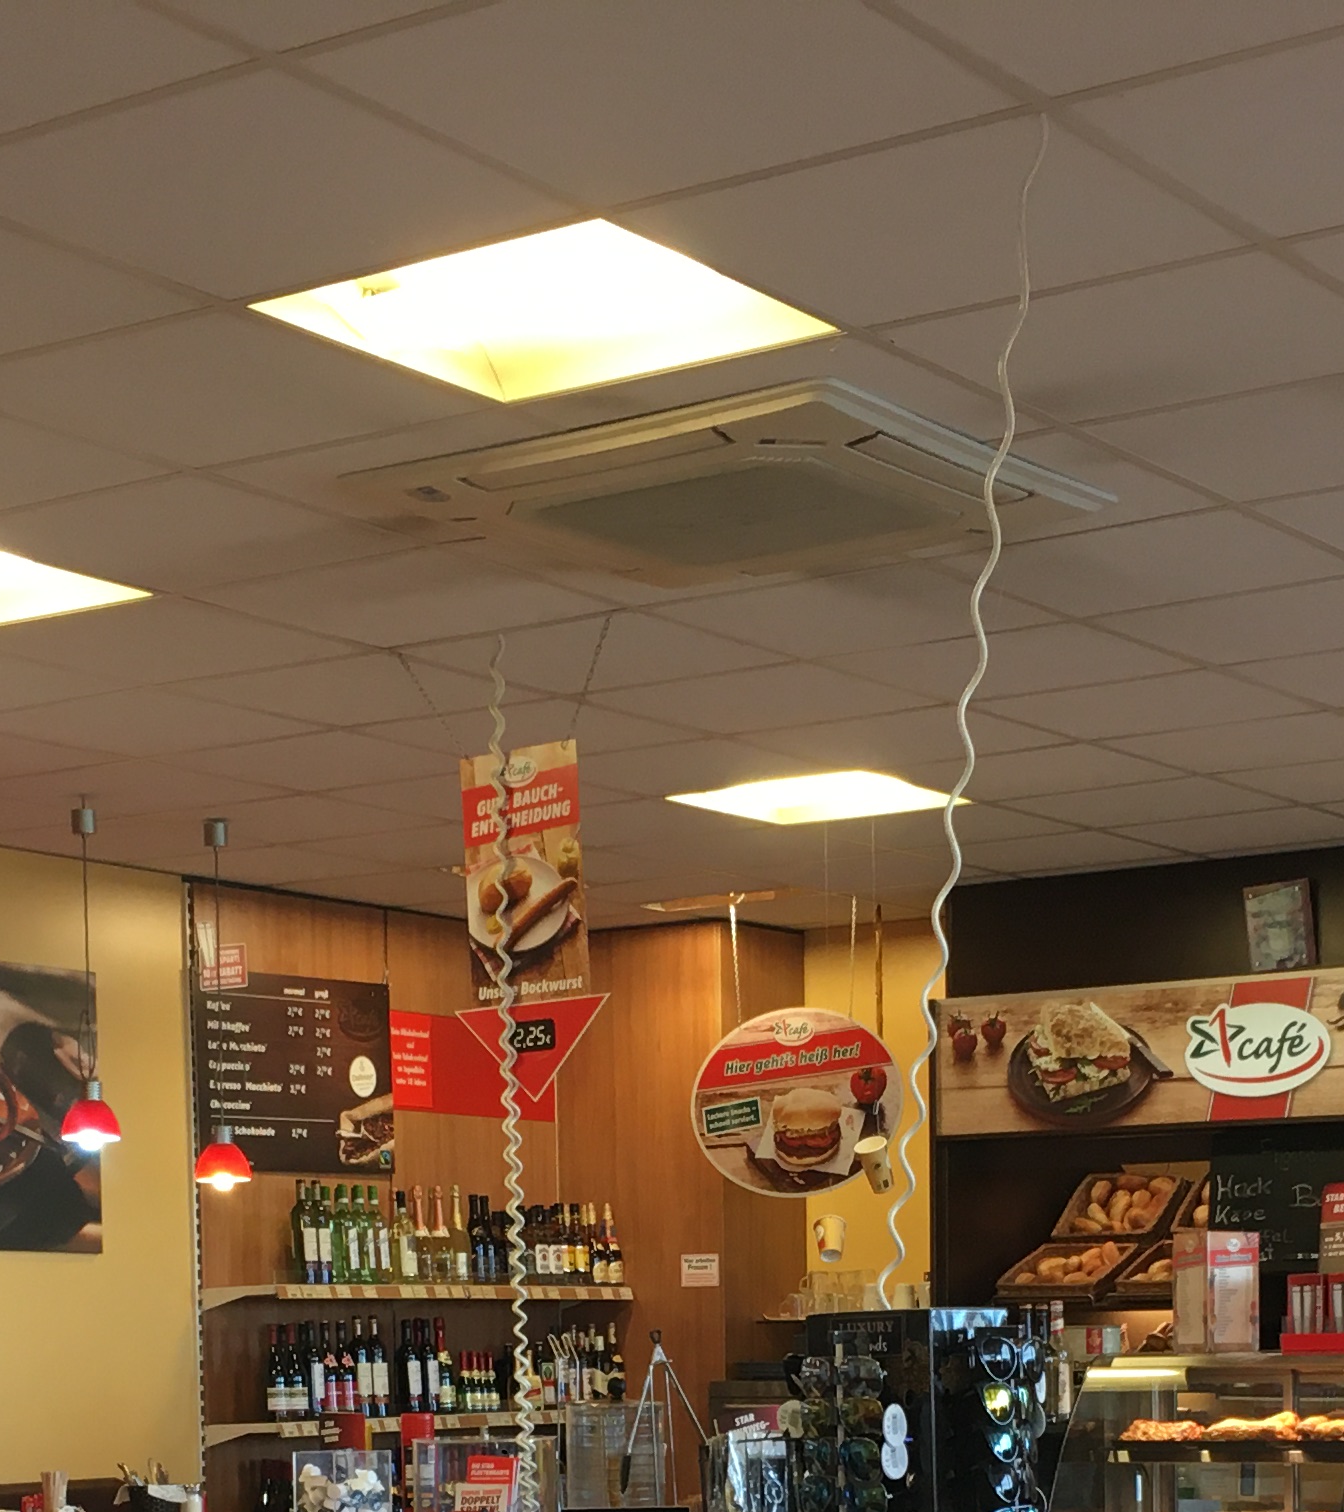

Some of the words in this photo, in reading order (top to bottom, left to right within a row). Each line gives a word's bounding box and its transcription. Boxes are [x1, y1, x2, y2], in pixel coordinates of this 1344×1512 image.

[477, 794, 510, 817] GUE
[513, 782, 564, 808] BAUCH-
[471, 800, 570, 838] ENTCHEIDUNG
[521, 976, 583, 995] Bockwurst
[724, 1059, 752, 1077] Hier
[754, 1054, 796, 1075] geht's
[799, 1048, 828, 1065] heiß
[833, 1043, 861, 1060] her!
[1237, 1021, 1311, 1074] café
[734, 1413, 755, 1428] STAR
[460, 1496, 502, 1506] DOPPELT
